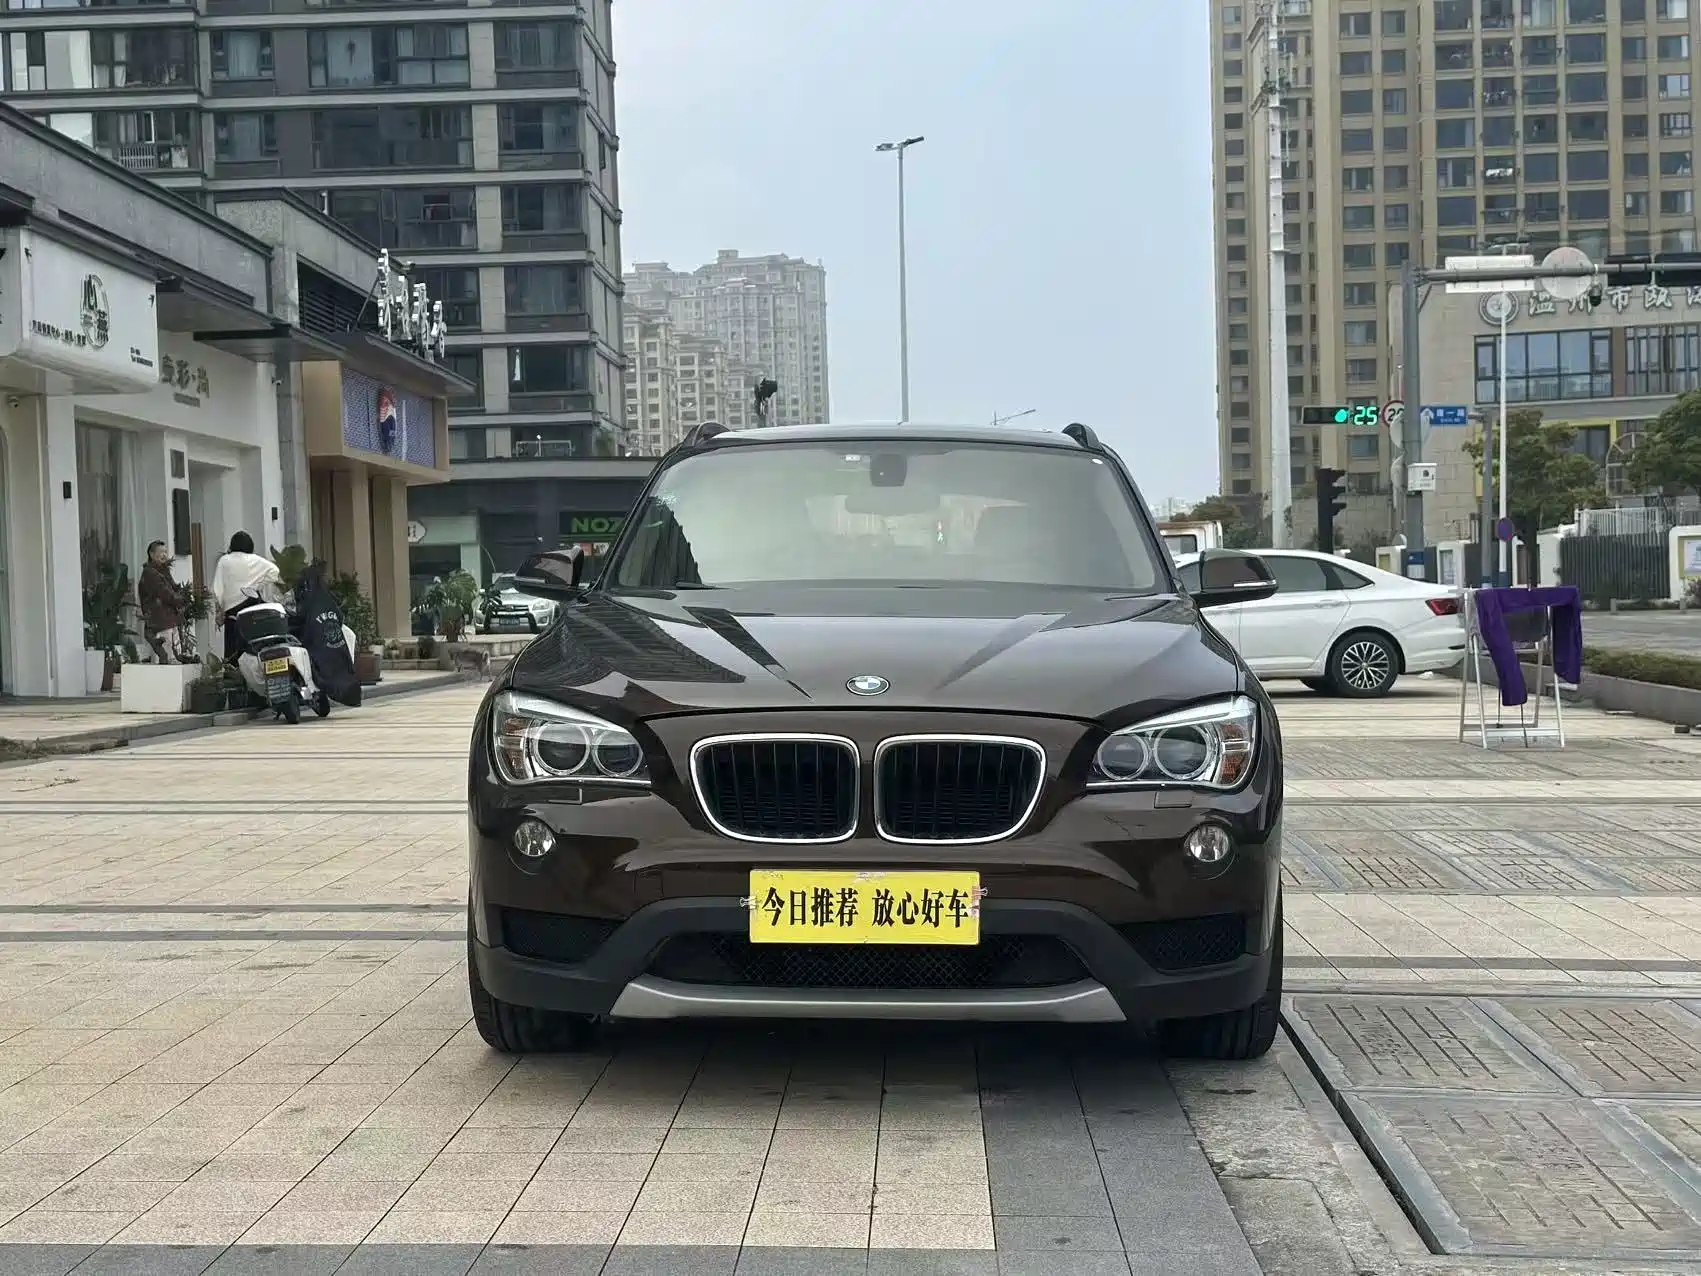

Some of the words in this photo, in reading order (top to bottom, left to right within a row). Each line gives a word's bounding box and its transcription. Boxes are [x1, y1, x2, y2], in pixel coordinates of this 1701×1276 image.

[1354, 406, 1377, 425] 25
[762, 886, 858, 927] 今日推荐
[872, 888, 969, 928] 放心好车
